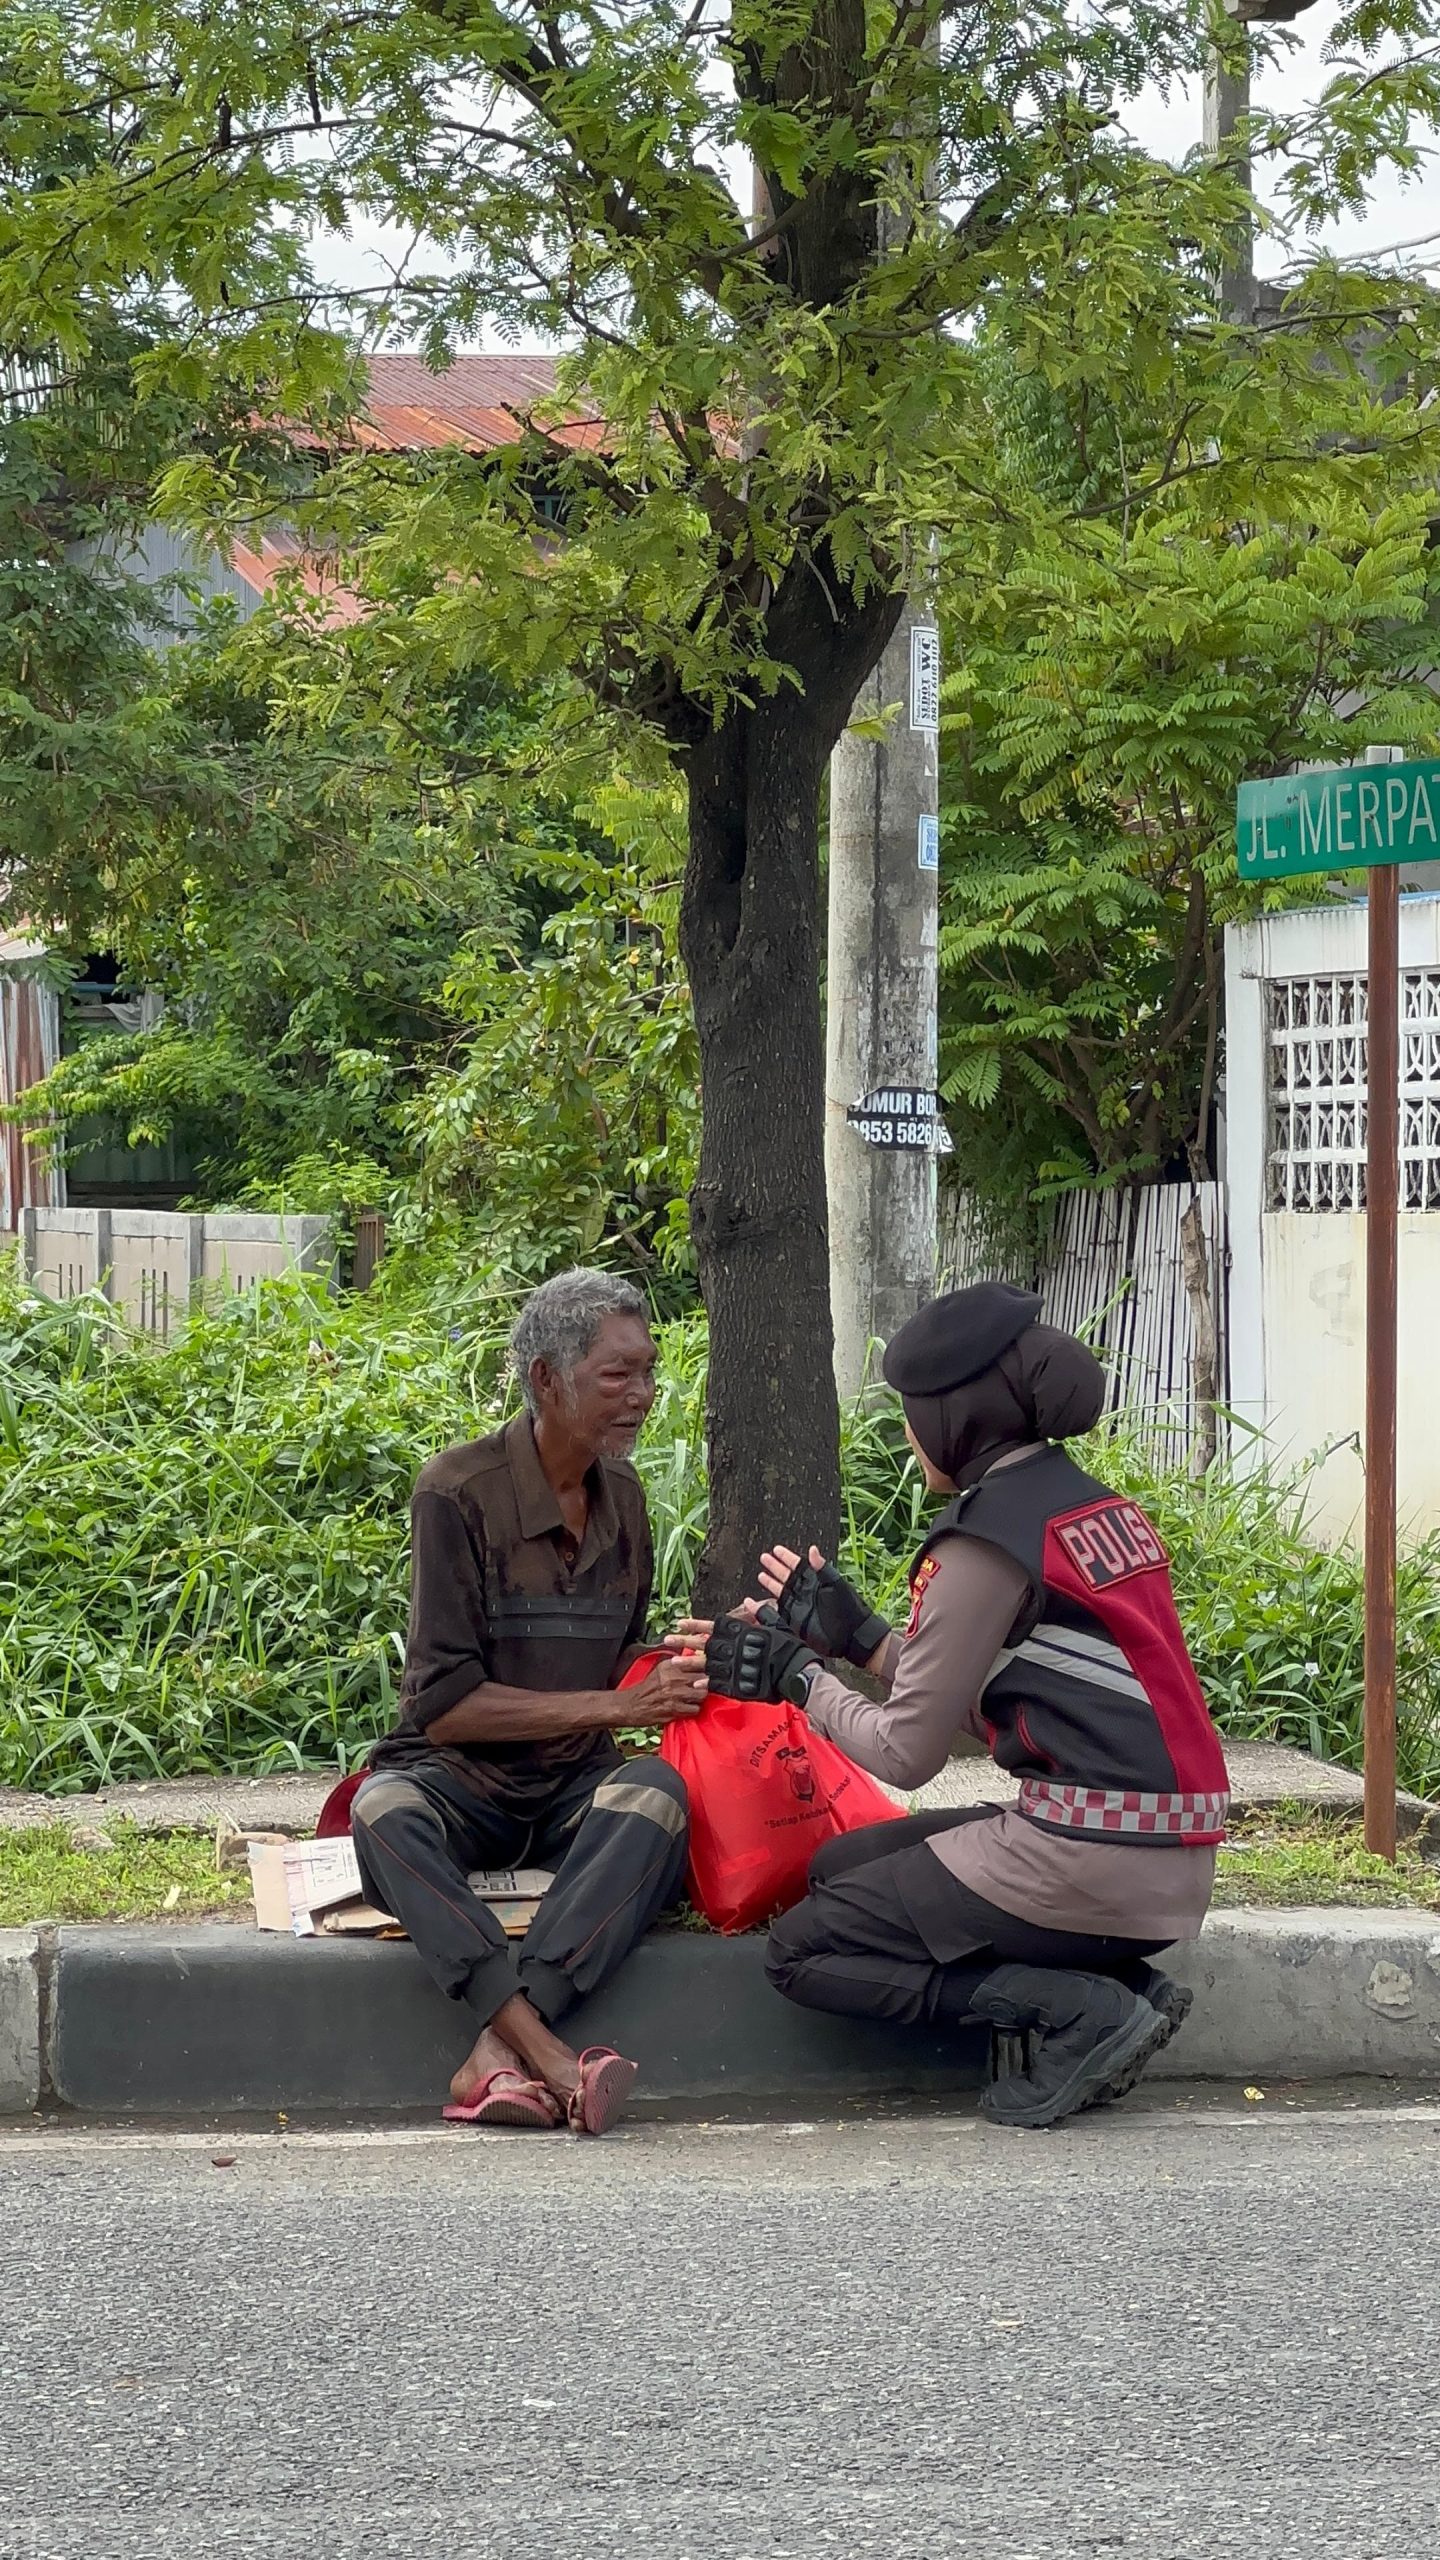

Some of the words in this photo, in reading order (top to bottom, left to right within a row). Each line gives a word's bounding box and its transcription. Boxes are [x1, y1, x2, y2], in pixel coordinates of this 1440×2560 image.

[921, 638, 931, 671] WC
[1246, 794, 1287, 862] JL.
[1059, 1505, 1167, 1585] POLISI
